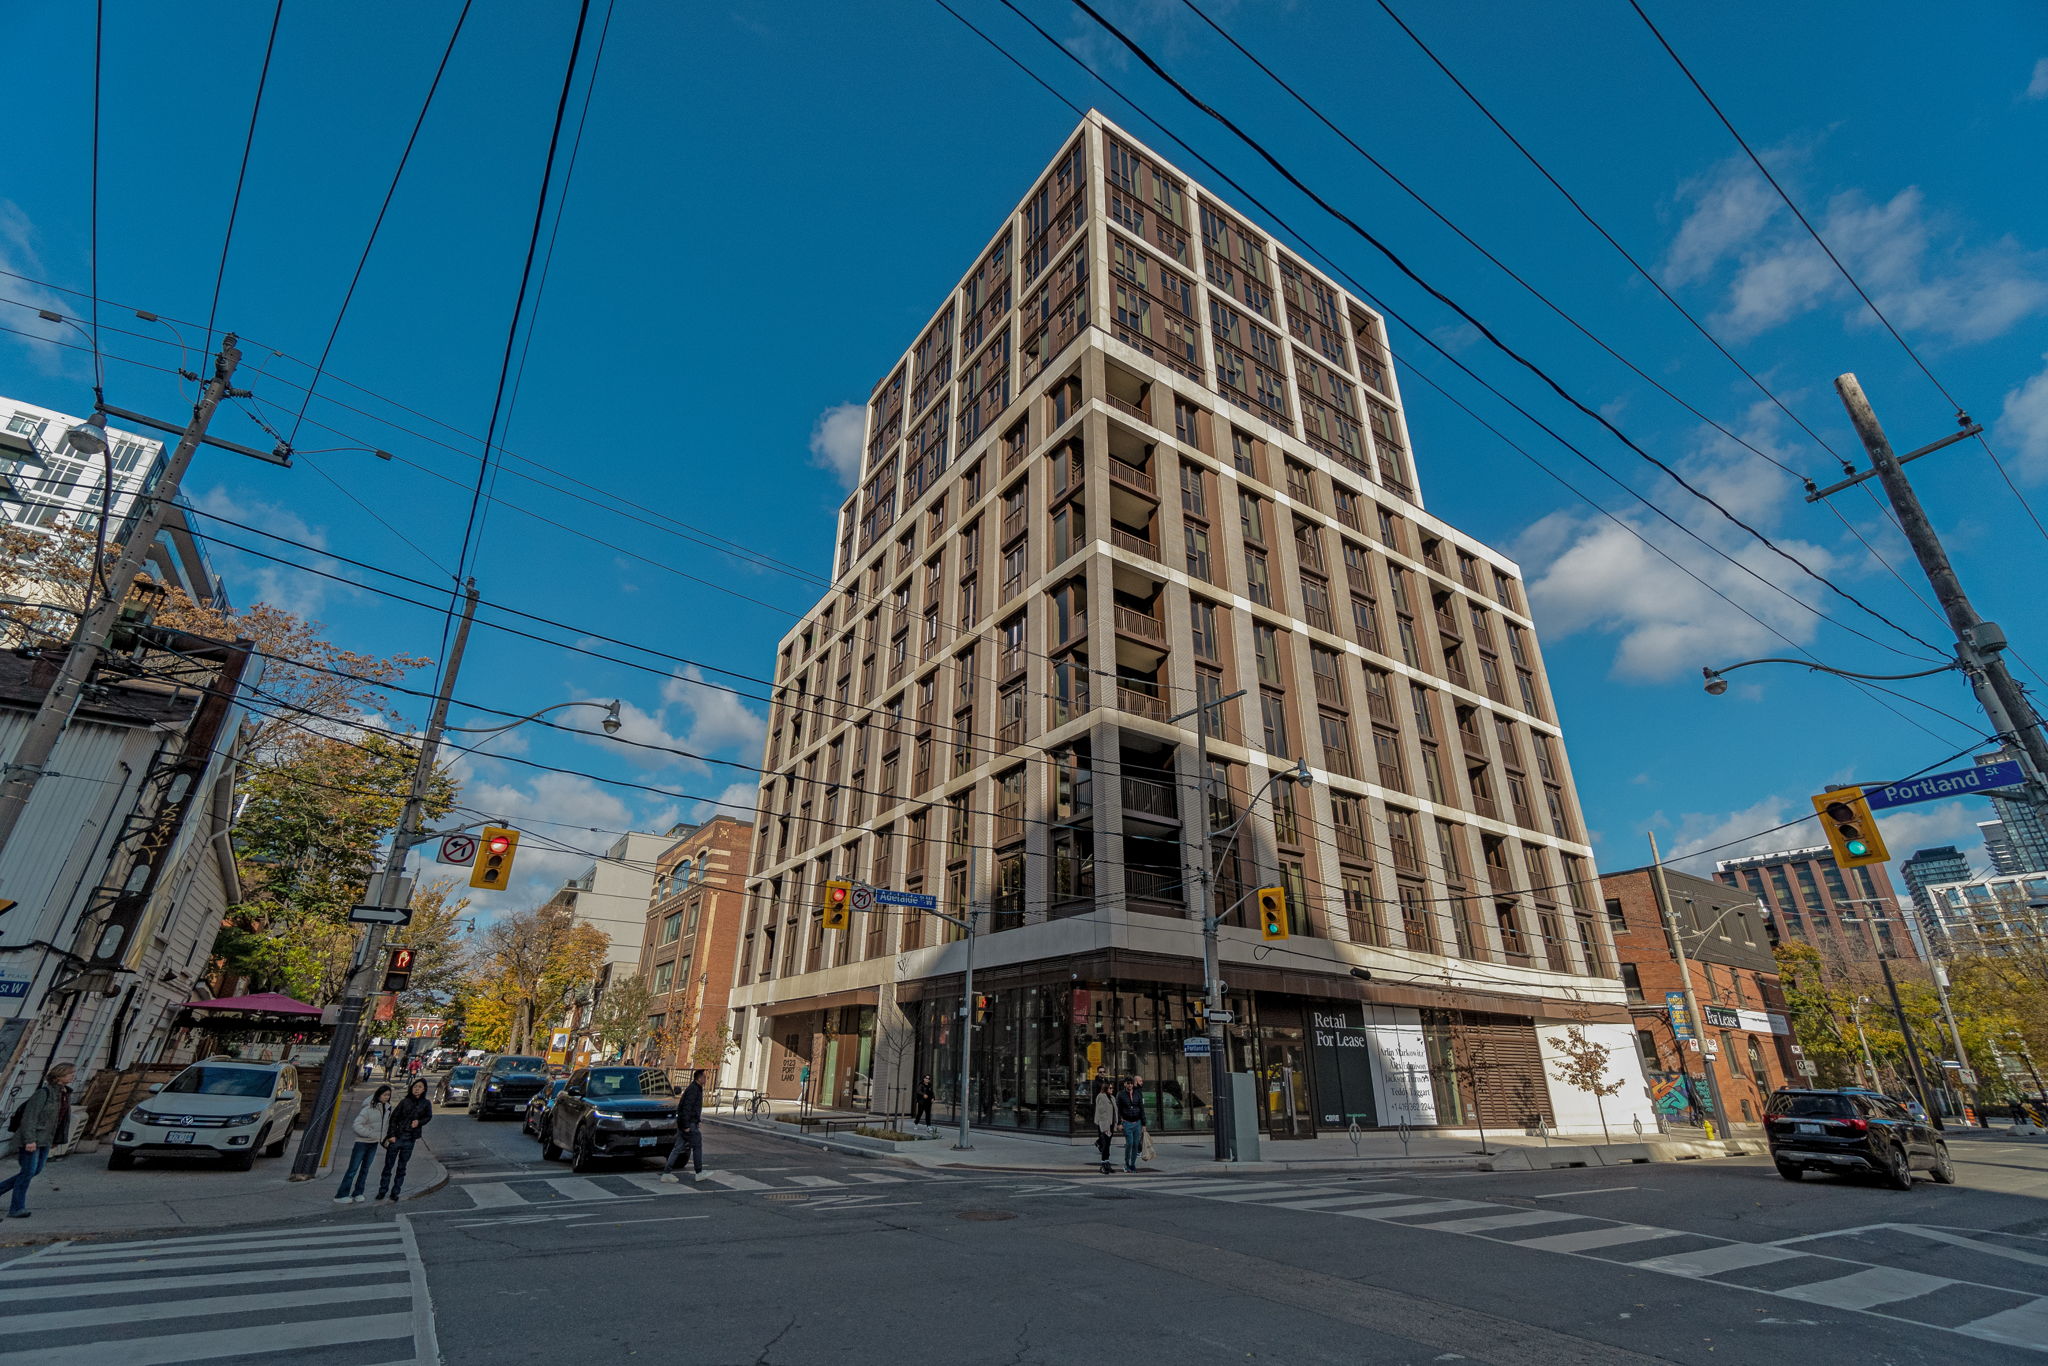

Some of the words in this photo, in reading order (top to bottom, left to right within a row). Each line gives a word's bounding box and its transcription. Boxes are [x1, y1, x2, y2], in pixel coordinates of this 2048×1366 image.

[1884, 770, 1981, 802] Portland
[1984, 766, 2000, 777] St
[880, 891, 919, 904] Adelaide
[0, 984, 9, 993] St
[11, 983, 23, 993] W
[1313, 1012, 1347, 1029] Retail
[1704, 1006, 1719, 1025] For
[1717, 1012, 1738, 1028] Lease
[1315, 1031, 1334, 1047] For
[1335, 1032, 1365, 1048] Lease
